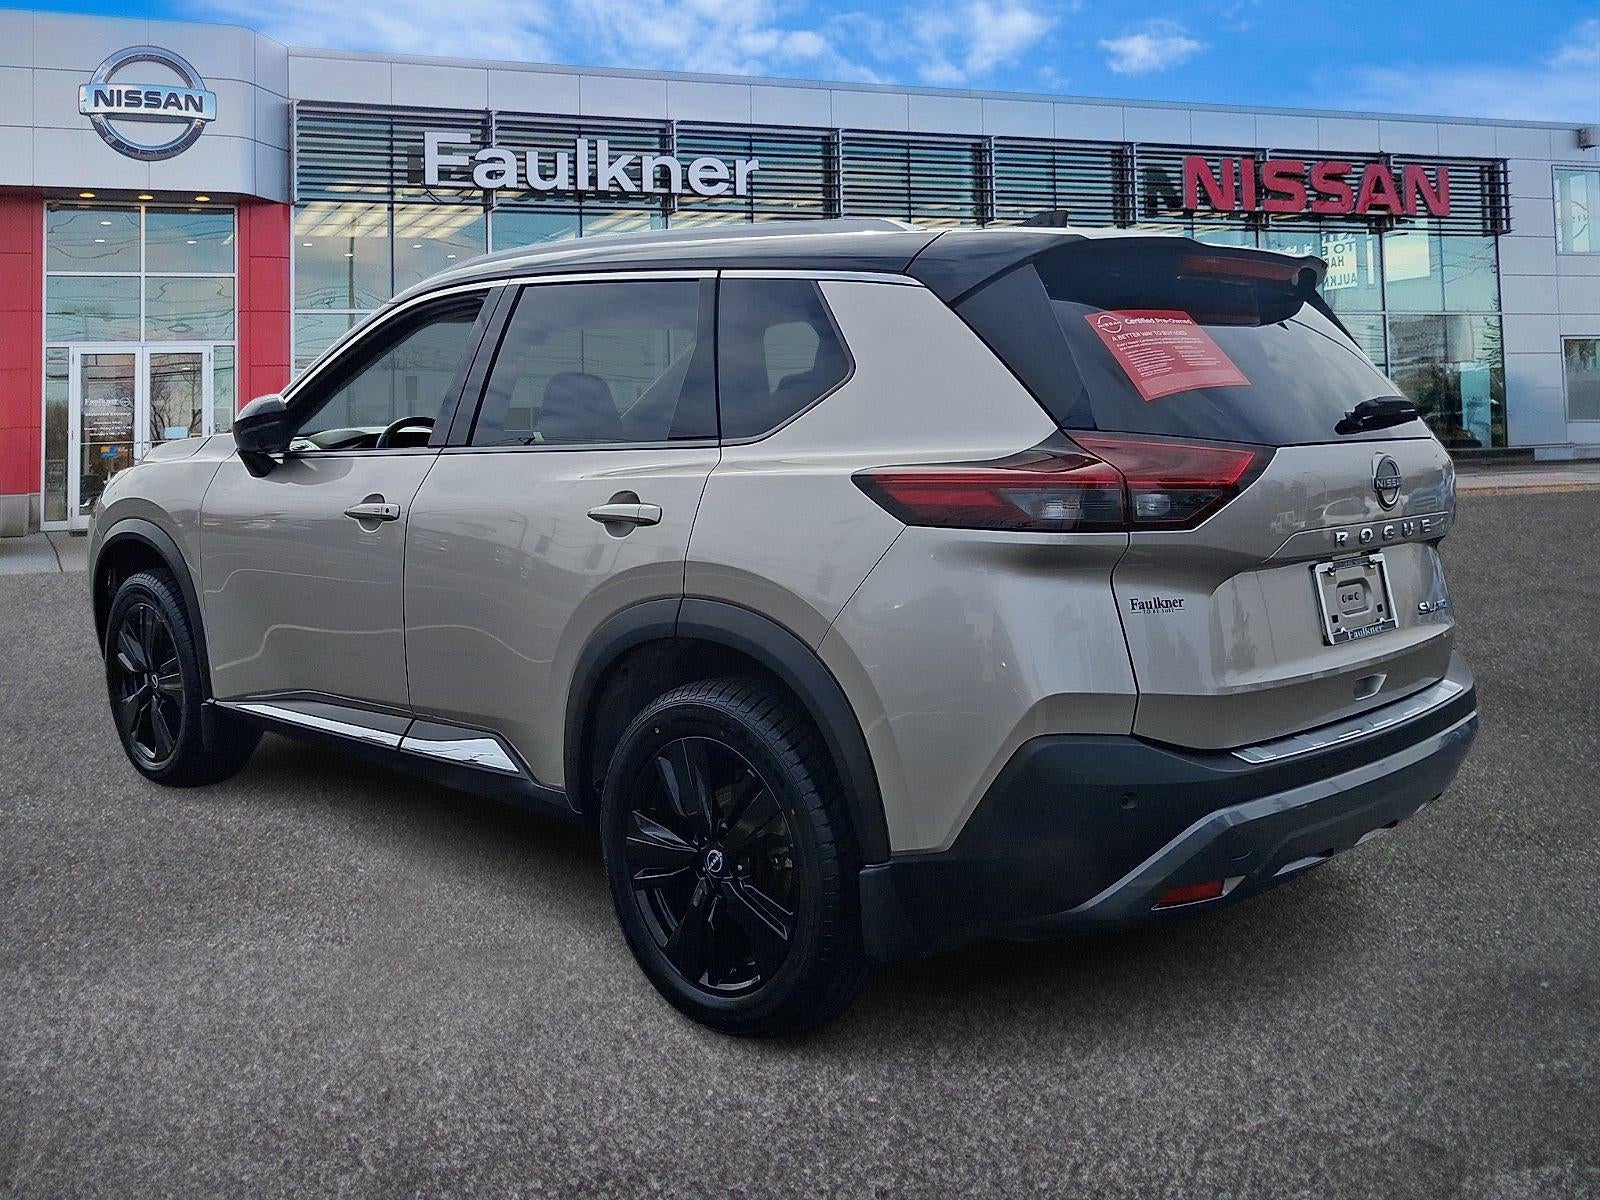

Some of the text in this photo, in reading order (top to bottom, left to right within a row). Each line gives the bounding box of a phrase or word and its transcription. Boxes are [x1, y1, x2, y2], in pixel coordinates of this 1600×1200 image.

[93, 89, 203, 113] NISSAN
[423, 131, 760, 196] Faulkner
[1182, 155, 1451, 216] NISSAN
[1124, 316, 1156, 325] Certified
[1117, 331, 1141, 341] BETTER
[1334, 518, 1433, 547] ROGUE
[1129, 596, 1184, 611] Faulkner
[1347, 624, 1384, 640] Faulkner
